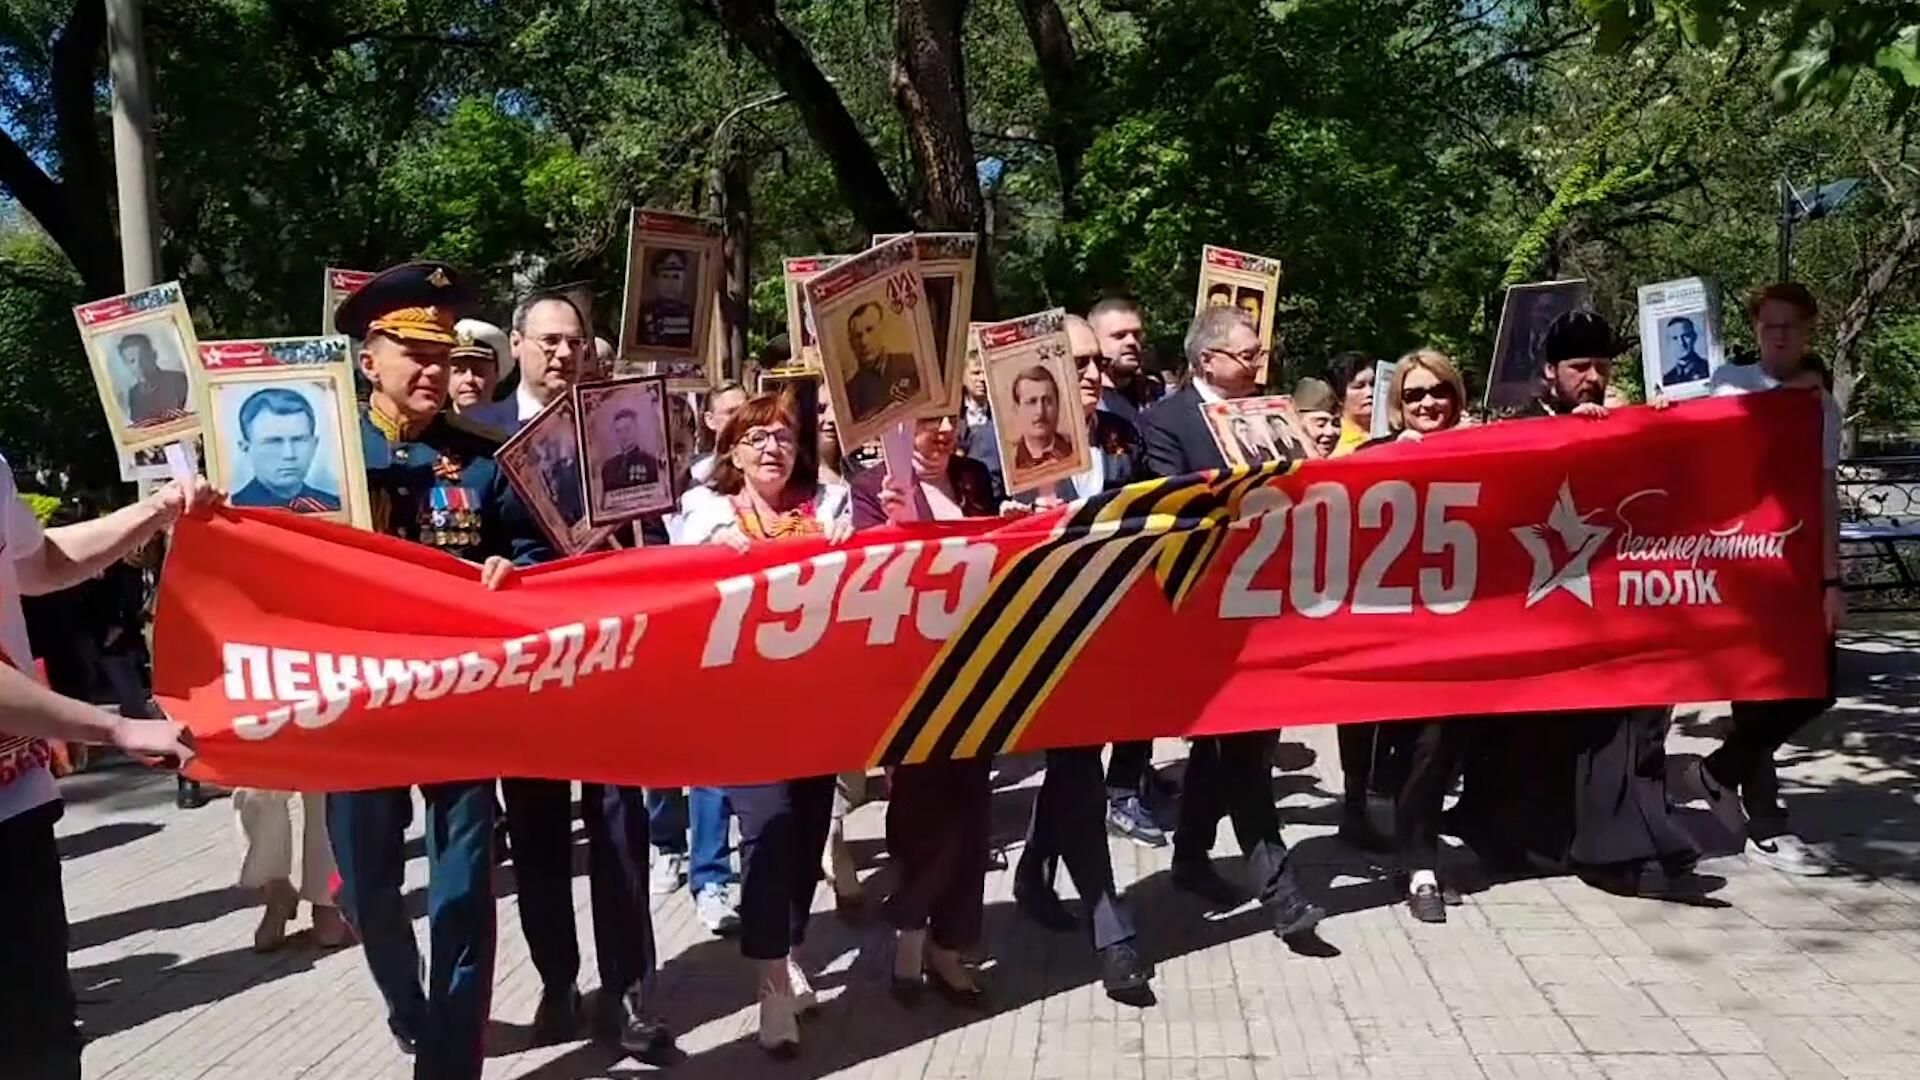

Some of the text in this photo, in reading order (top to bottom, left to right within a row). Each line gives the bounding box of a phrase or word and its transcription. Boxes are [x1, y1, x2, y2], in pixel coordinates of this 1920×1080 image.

[701, 480, 1482, 668] 1945 2025
[1618, 569, 1722, 606] ПОЛК
